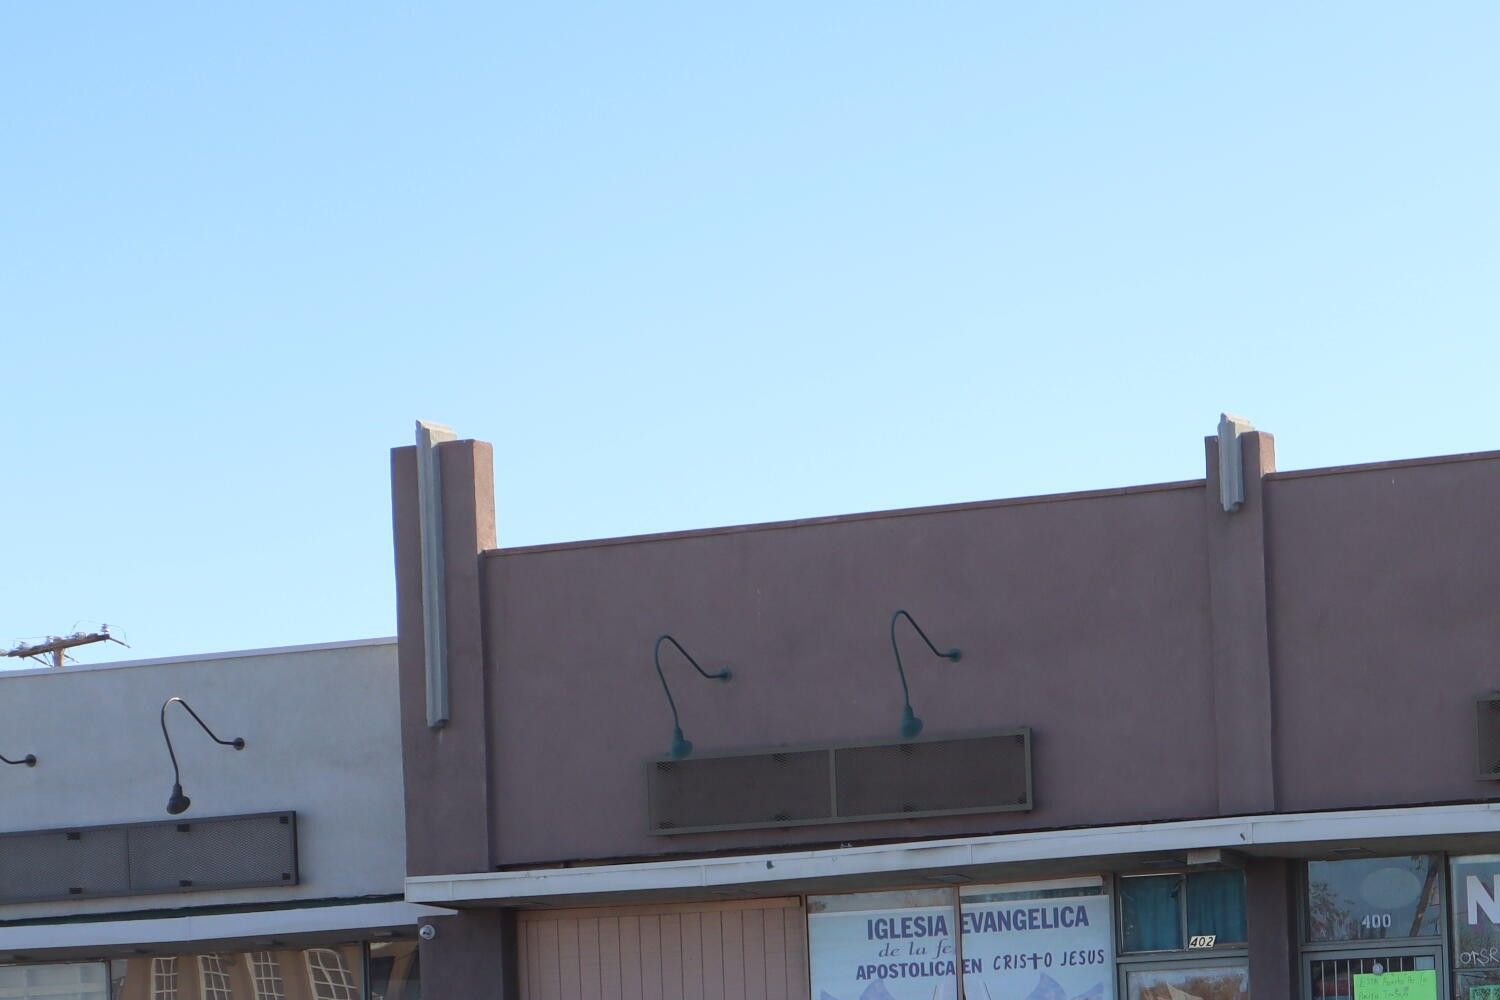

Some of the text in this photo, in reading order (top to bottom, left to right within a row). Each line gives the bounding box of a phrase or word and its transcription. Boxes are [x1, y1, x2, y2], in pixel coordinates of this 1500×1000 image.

[867, 905, 1090, 941] IGLESIA EVANGELICA
[1361, 913, 1392, 930] 400
[878, 942, 901, 958] de
[908, 940, 927, 957] la
[1189, 935, 1215, 948] 402
[856, 960, 956, 981] APOSTOLICA
[961, 958, 983, 975] EN
[1060, 949, 1105, 968] JESUS
